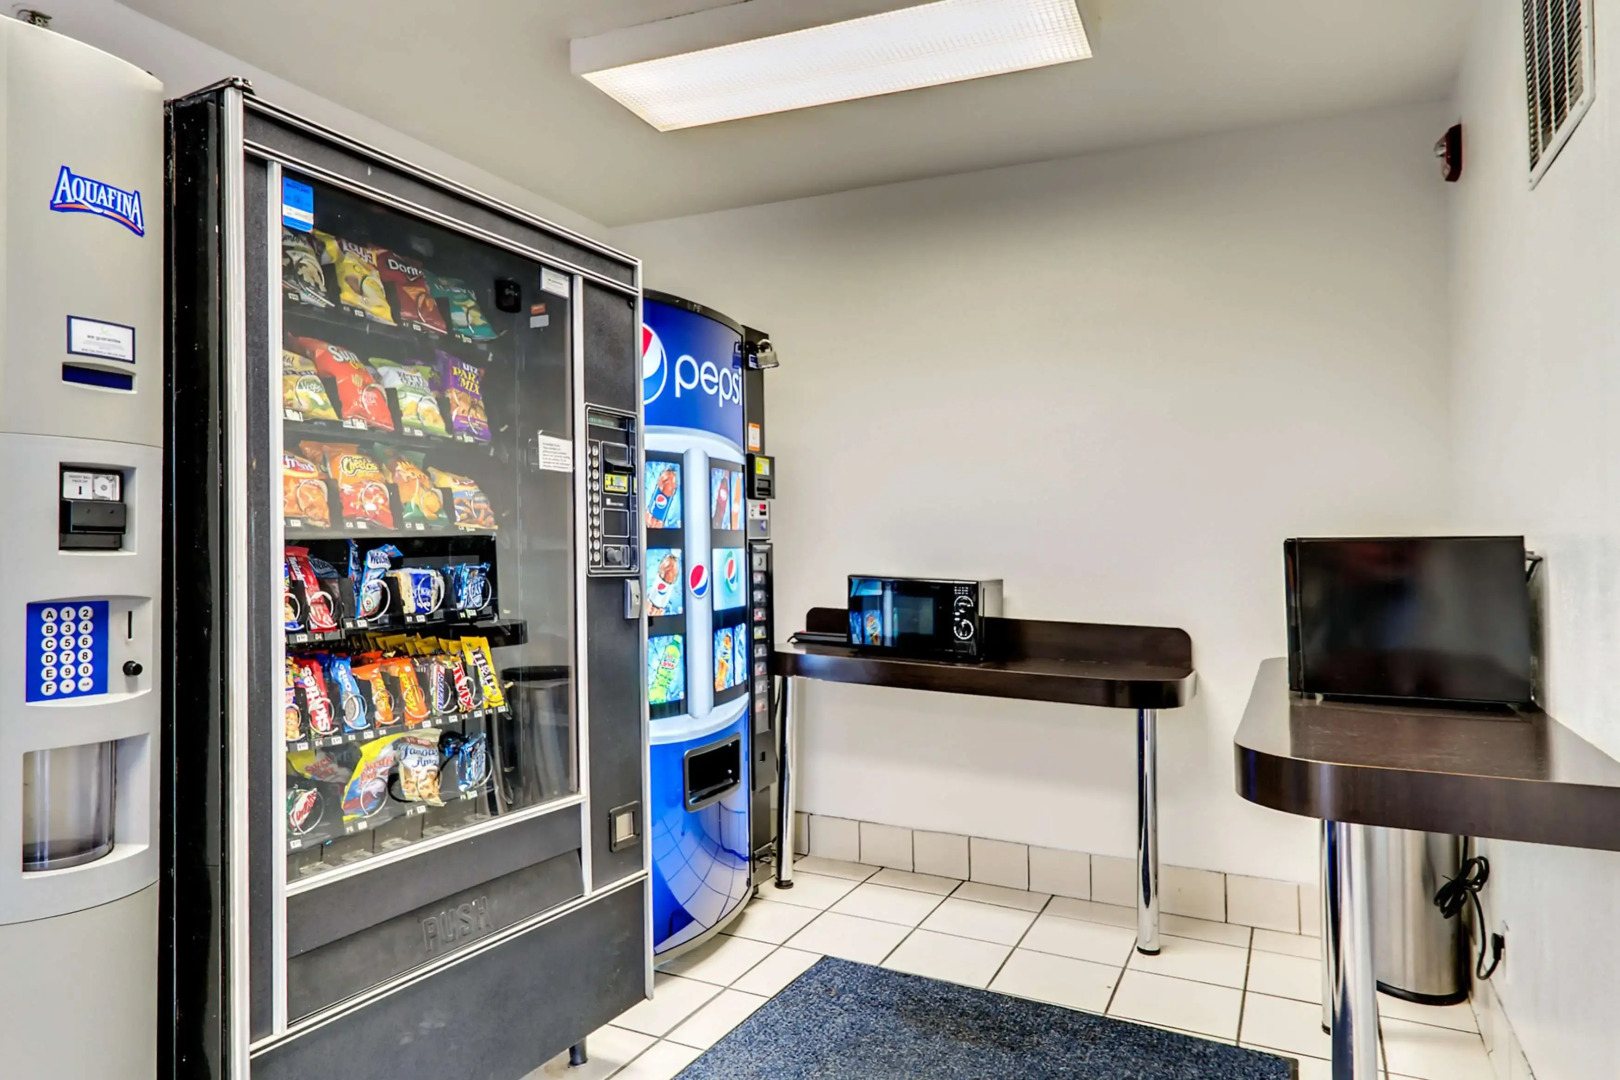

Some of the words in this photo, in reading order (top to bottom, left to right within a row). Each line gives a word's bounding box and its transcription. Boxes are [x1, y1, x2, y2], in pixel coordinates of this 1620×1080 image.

[53, 165, 144, 231] AQUAFINA
[674, 354, 743, 408] pepsi
[46, 611, 53, 619] A
[66, 610, 70, 618] 1
[83, 609, 88, 617] 2
[46, 625, 53, 634] B
[65, 624, 71, 633] 3
[82, 623, 88, 631] 4
[45, 640, 53, 648] C
[65, 639, 70, 647] 5
[82, 638, 88, 646] 6
[46, 655, 53, 663] D
[64, 653, 70, 661] 7
[82, 652, 88, 660] 8
[46, 669, 53, 678] E
[65, 668, 70, 676] 9
[83, 666, 88, 674] 0
[46, 684, 53, 692] F
[422, 895, 494, 952] PUSH
